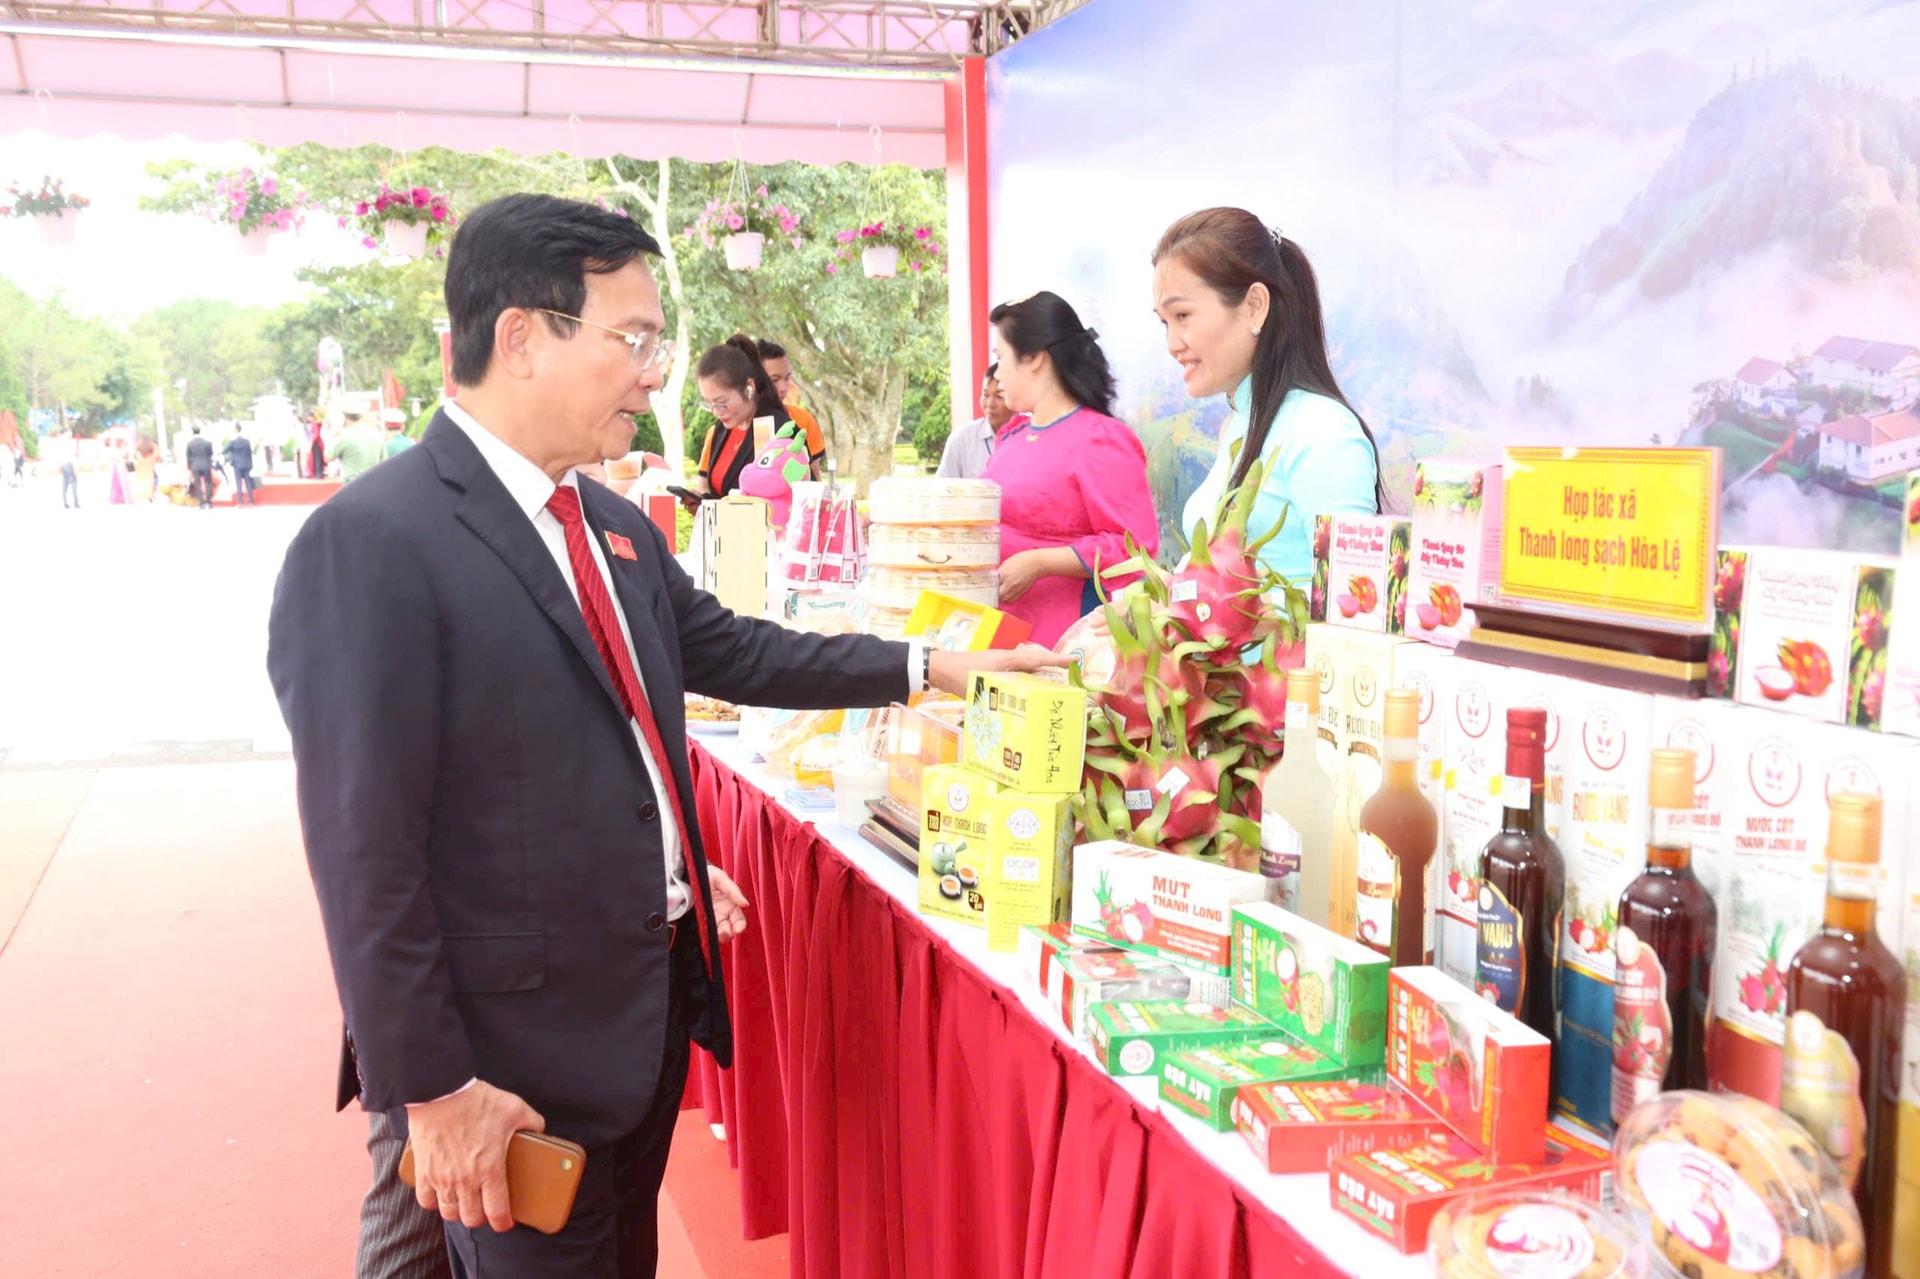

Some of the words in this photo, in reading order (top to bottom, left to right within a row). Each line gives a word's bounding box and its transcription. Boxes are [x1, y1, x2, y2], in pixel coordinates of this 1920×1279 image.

[1564, 485, 1591, 525] Hợp
[1594, 486, 1616, 520] tác
[1618, 487, 1637, 521] xã
[1519, 527, 1559, 561] Thanh
[1561, 530, 1591, 569] long
[1593, 532, 1628, 573] sạch
[1631, 534, 1659, 570] Hòa
[1663, 534, 1682, 581] Lệ
[973, 820, 987, 836] LONG
[1006, 857, 1037, 872] OCOP
[968, 892, 979, 904] 20
[1152, 894, 1189, 914] THANH
[1192, 904, 1223, 922] LONG
[1483, 922, 1514, 949] VANG
